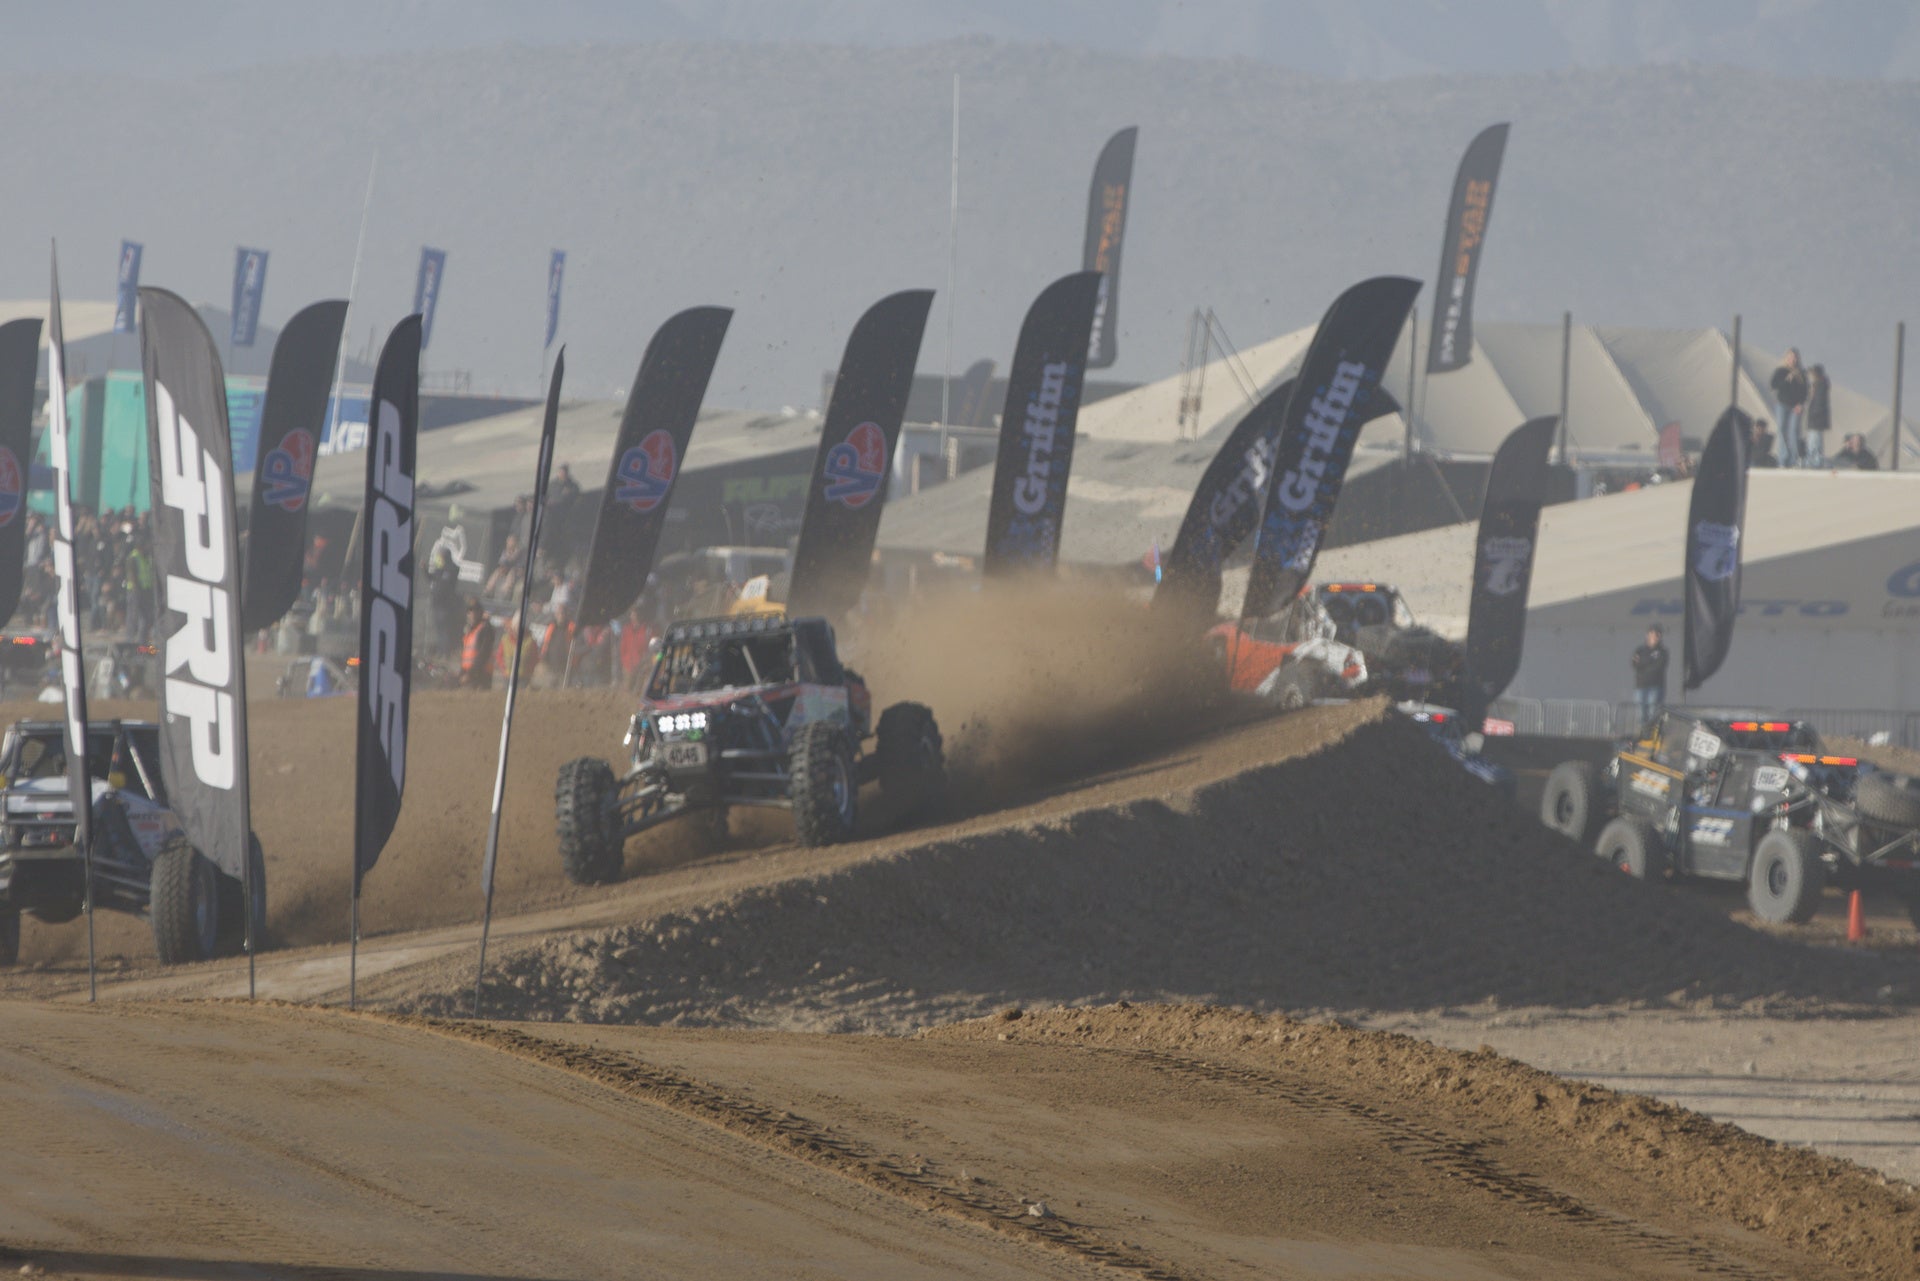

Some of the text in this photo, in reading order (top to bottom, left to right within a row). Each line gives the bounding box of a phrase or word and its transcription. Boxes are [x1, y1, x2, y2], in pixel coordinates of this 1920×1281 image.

[262, 447, 313, 506] VP
[615, 445, 673, 503] VP
[824, 441, 882, 504] VP
[1013, 361, 1067, 514] Griffin
[1278, 360, 1366, 511] Griffin
[155, 380, 234, 790] PRP
[367, 399, 413, 797] PRP
[1630, 600, 1850, 617] NTO
